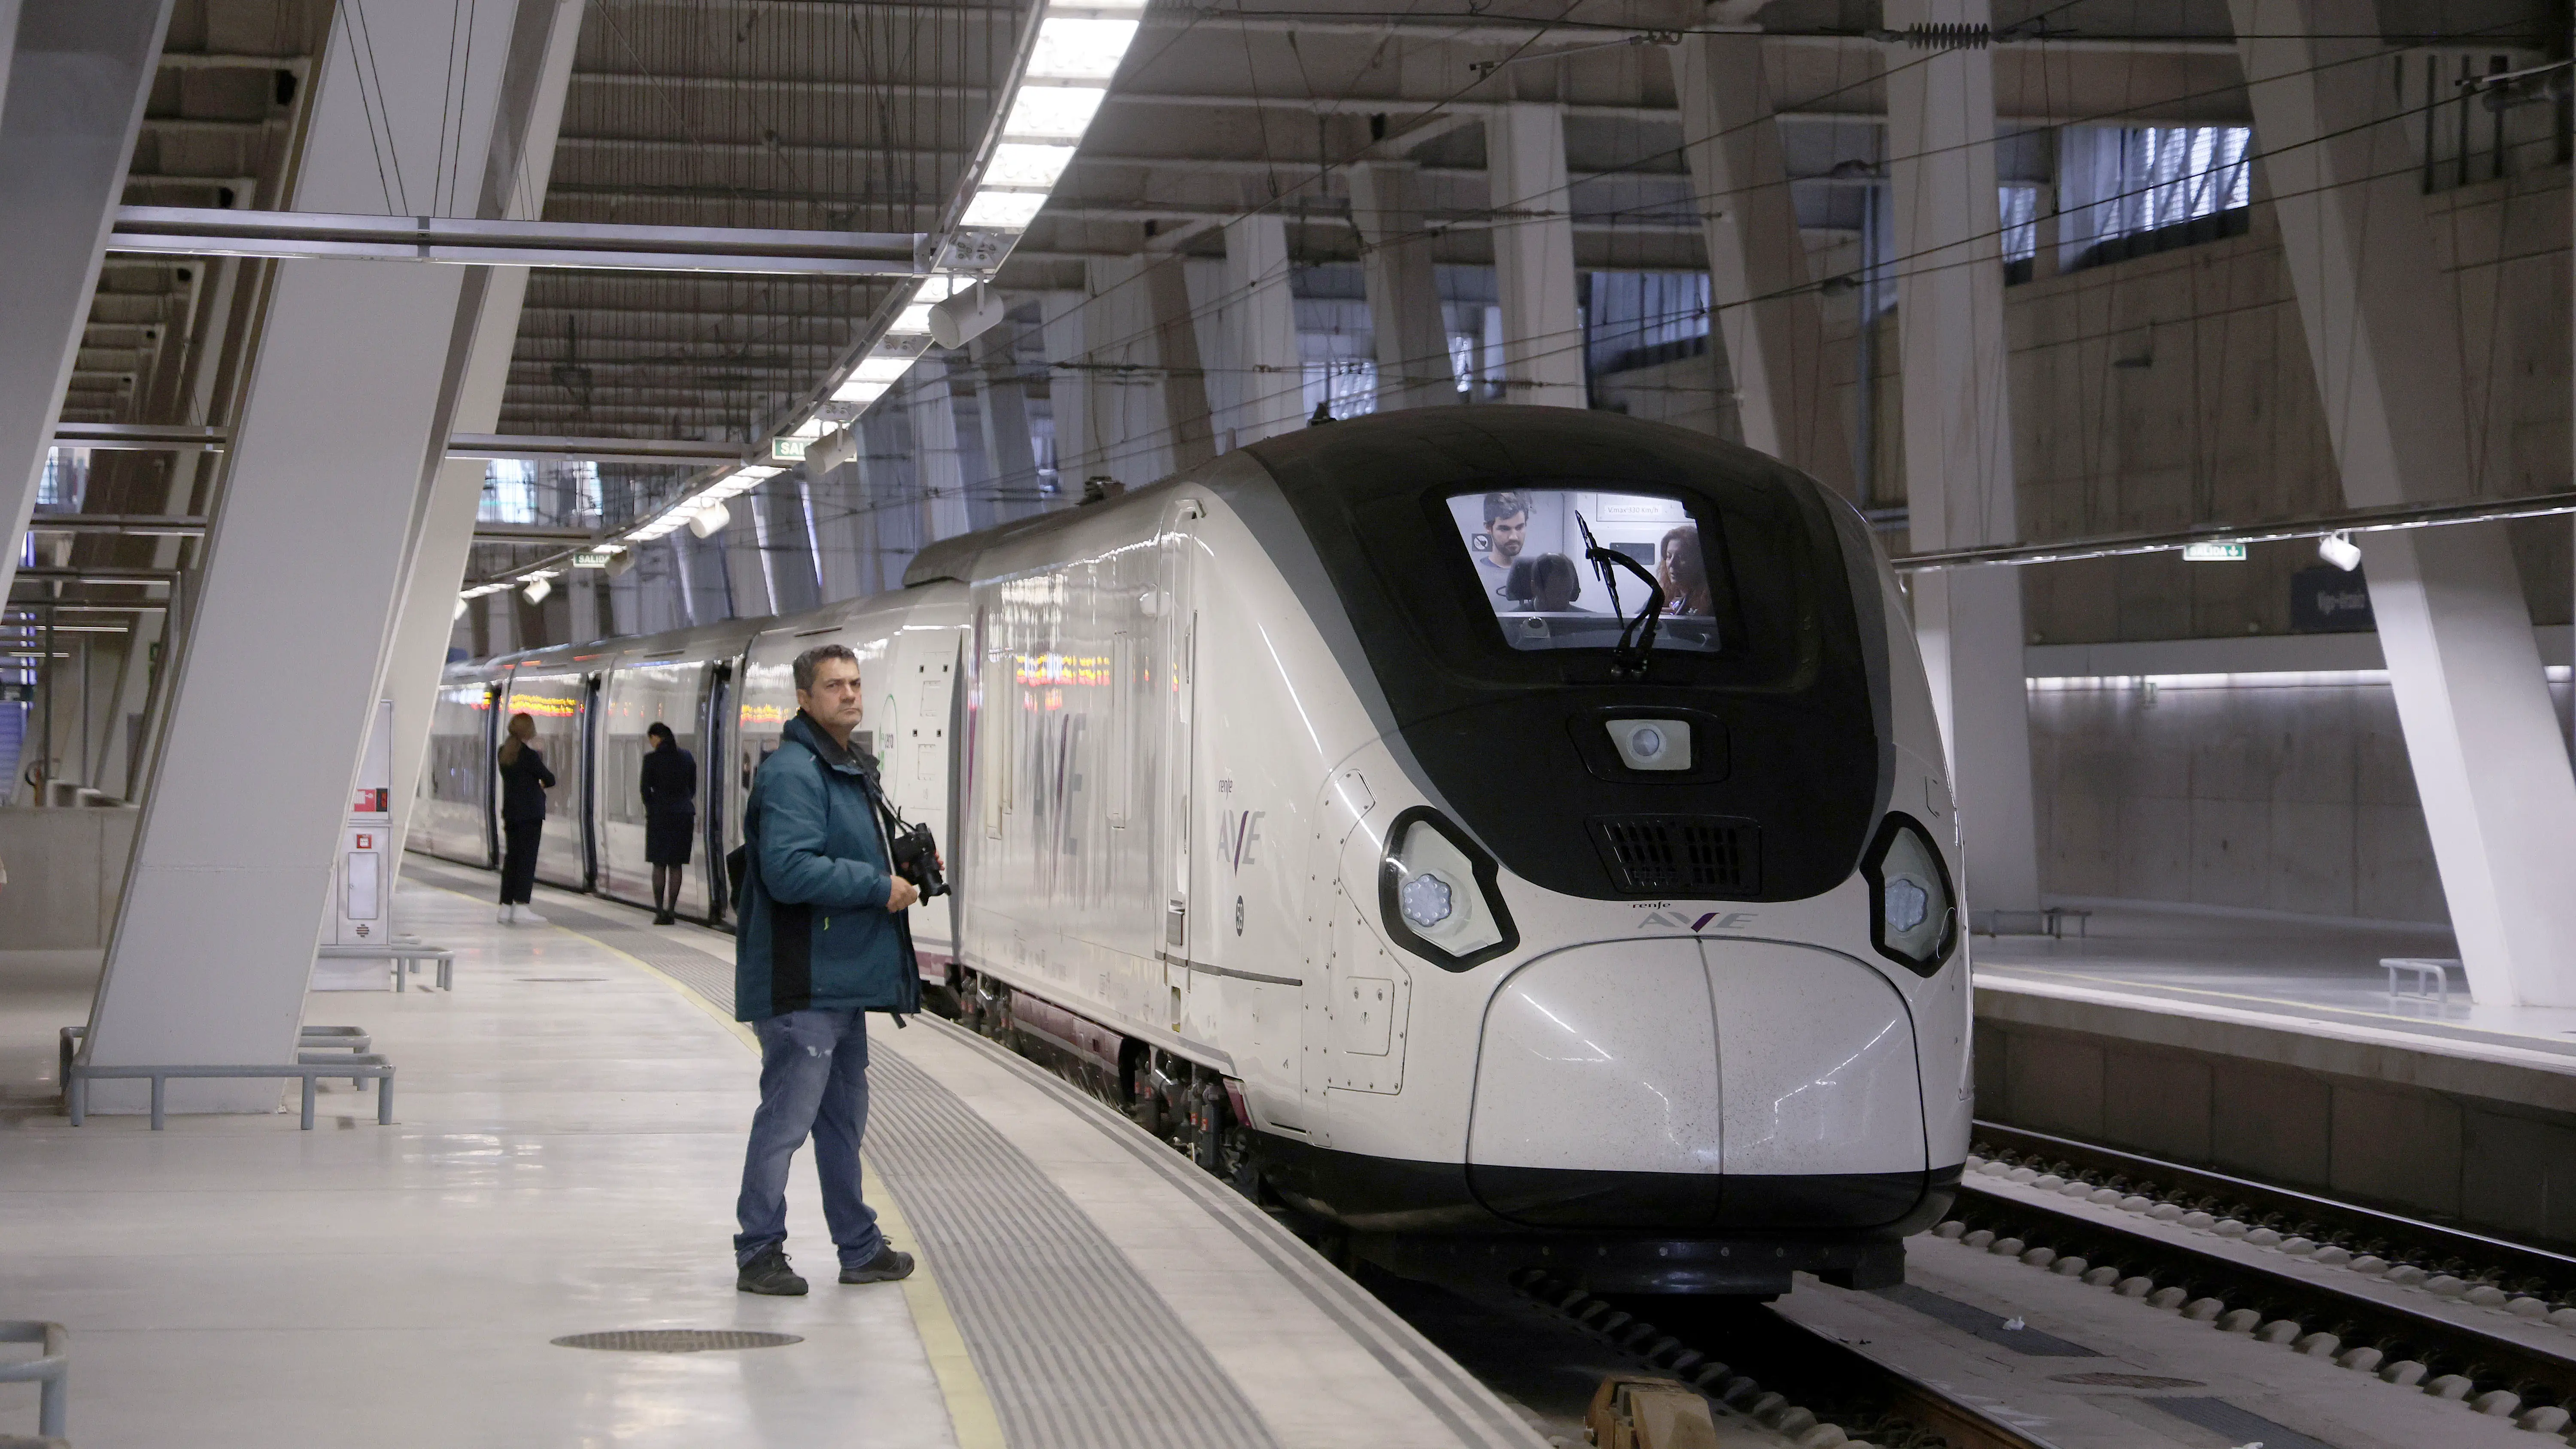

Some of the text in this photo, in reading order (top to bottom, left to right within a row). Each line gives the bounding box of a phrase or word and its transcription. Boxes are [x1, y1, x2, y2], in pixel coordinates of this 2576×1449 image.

[781, 442, 805, 455] SAL
[2190, 546, 2227, 556] SALIDA
[1218, 773, 1233, 800] renfe
[1216, 809, 1266, 878] AVE
[1632, 901, 1671, 910] renfe
[1637, 911, 1759, 933] AVE
